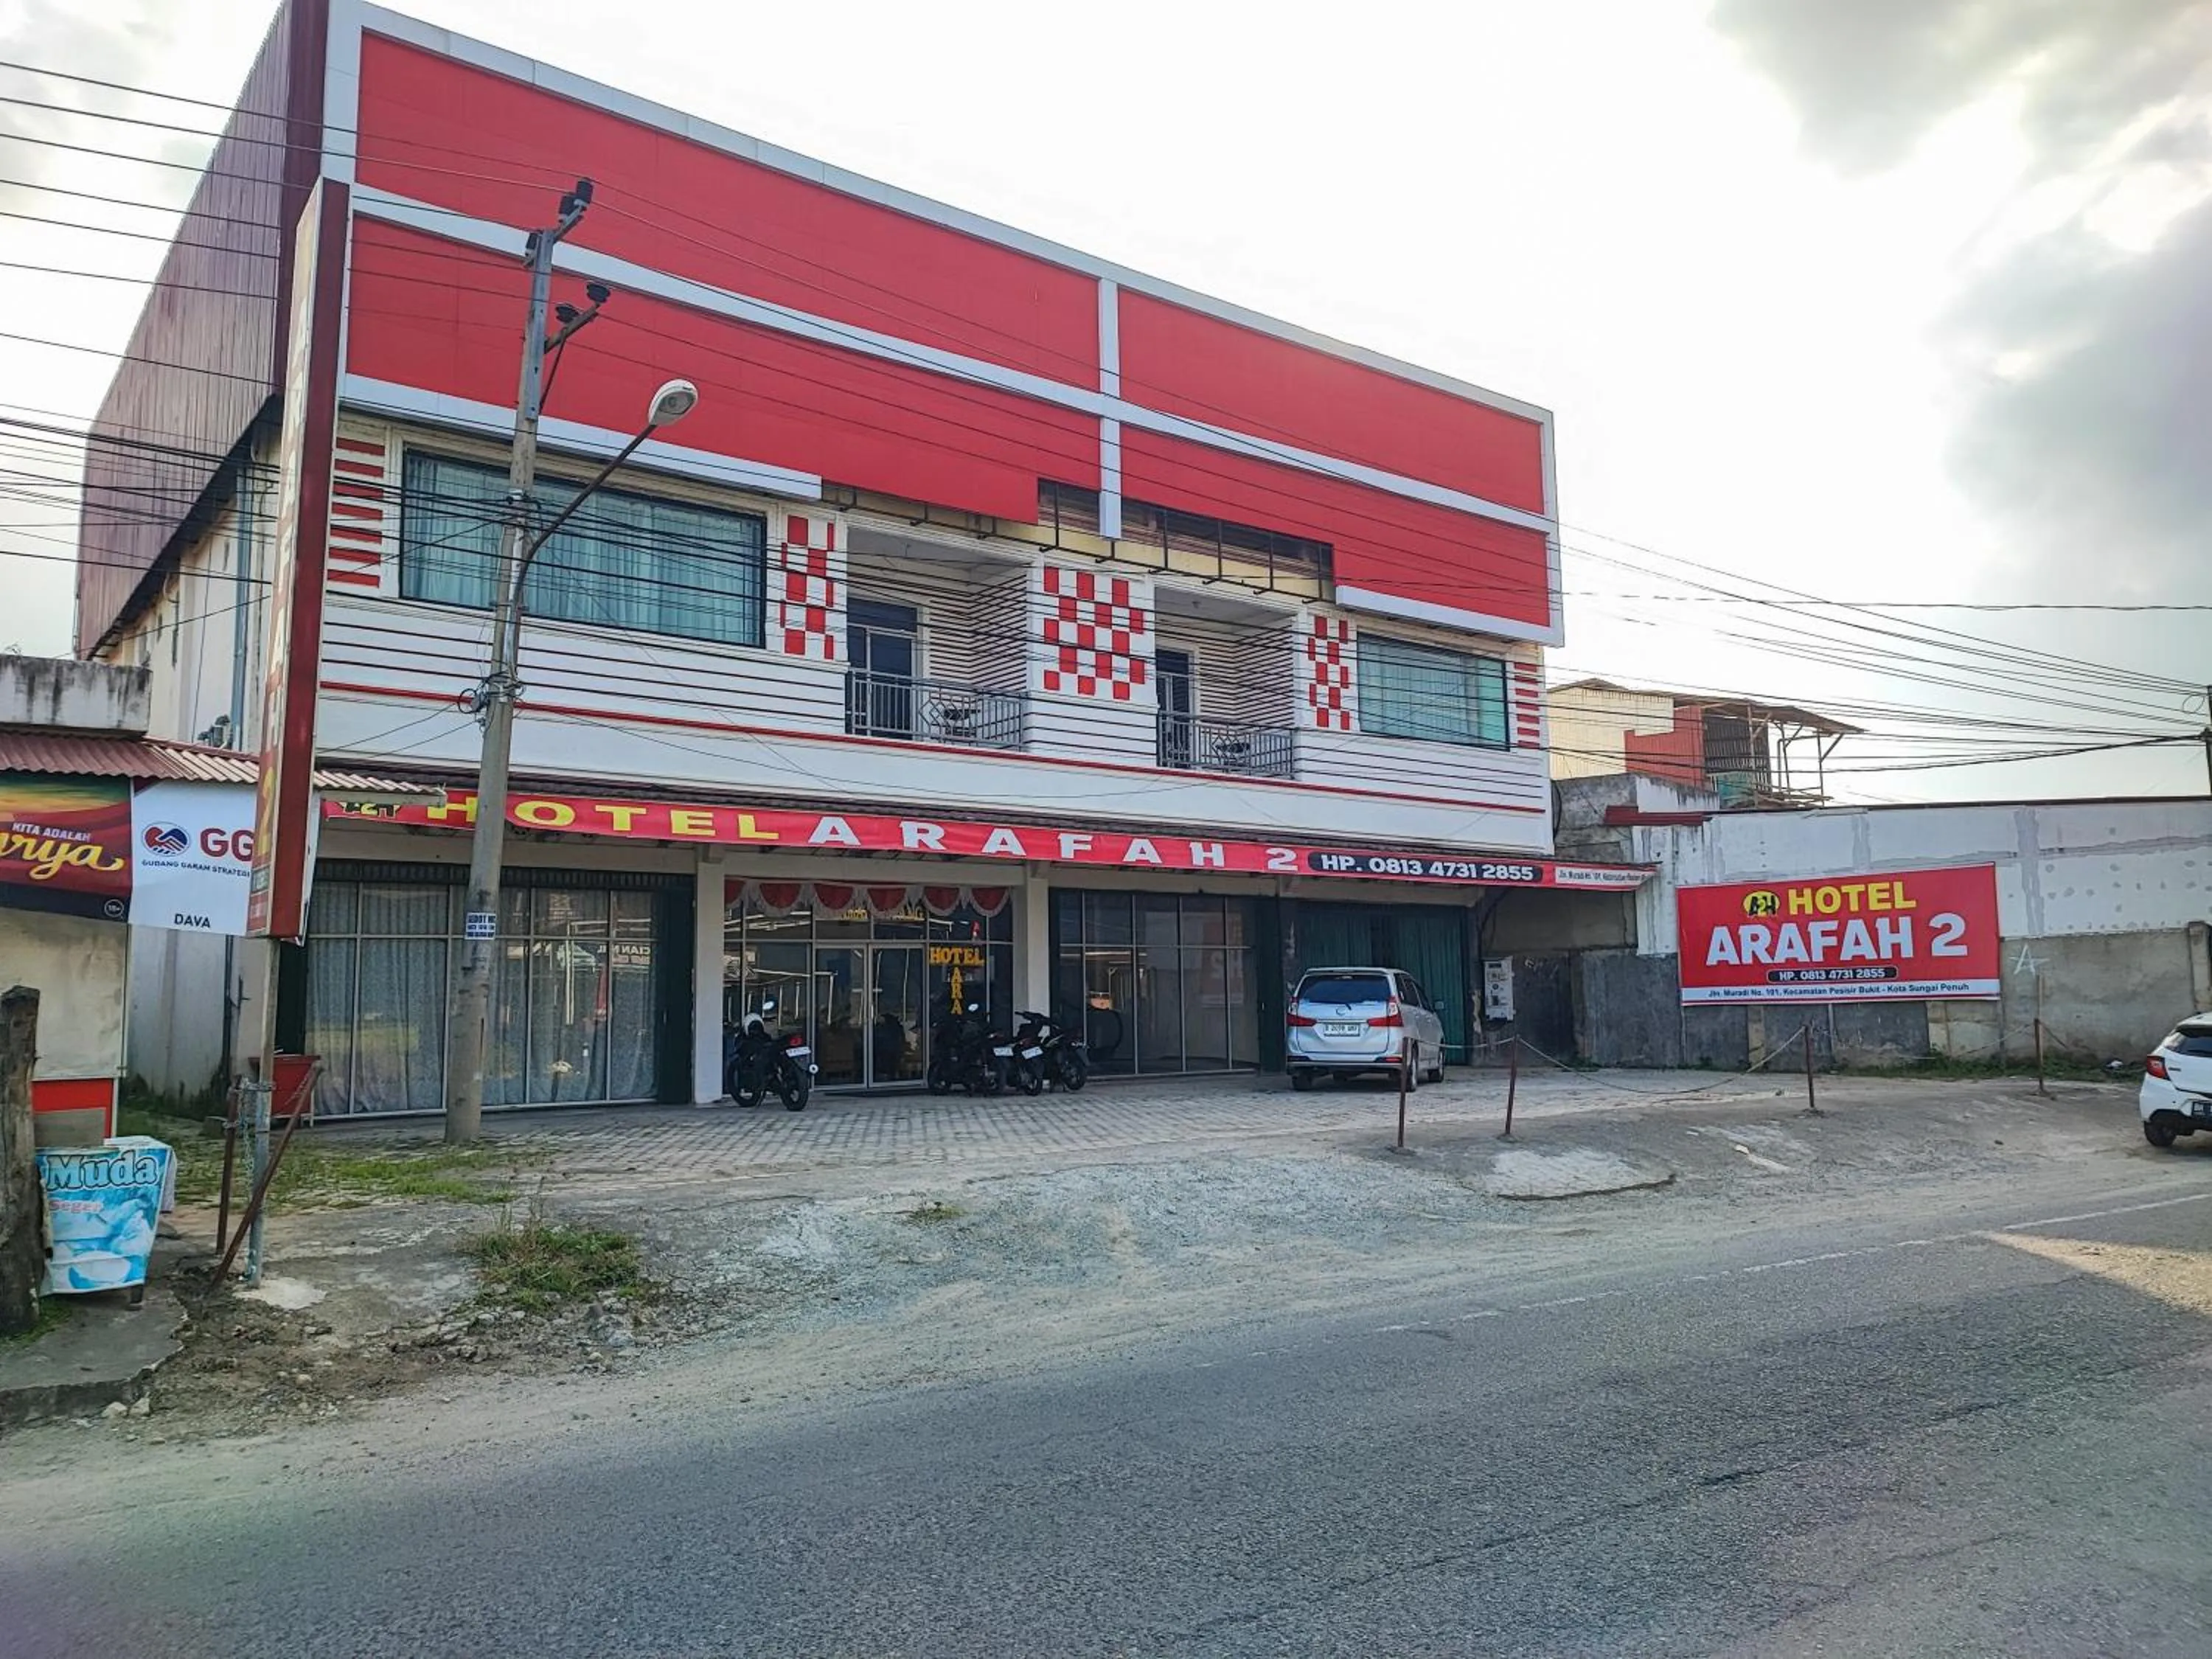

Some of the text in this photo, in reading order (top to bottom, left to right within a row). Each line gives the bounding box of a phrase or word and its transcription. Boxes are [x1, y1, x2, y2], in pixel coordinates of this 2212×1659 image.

[12, 822, 91, 842] KITA ADALAH
[427, 796, 779, 840] HOTEL
[808, 816, 1225, 867] ARAFAH
[1267, 847, 1298, 872] 2
[142, 859, 179, 868] GUDANG
[181, 862, 210, 872] GARAM
[1321, 855, 1533, 881] HP. 0813 4731 2855
[1788, 881, 1917, 915] HOTEL
[174, 913, 211, 928] DAVA
[1705, 912, 1969, 966] ARAFAH 2
[930, 947, 985, 966] HOTEL
[1778, 968, 1886, 981] HP. 0813 4731 2855
[1783, 987, 1828, 995] Kecamatan
[1829, 986, 1857, 995] Pesisir
[1858, 985, 1880, 995] Bukit
[1887, 984, 1907, 993] Kota
[1908, 984, 1938, 994] Sungai
[1940, 983, 1970, 992] Penuh
[46, 1150, 158, 1191] Muda
